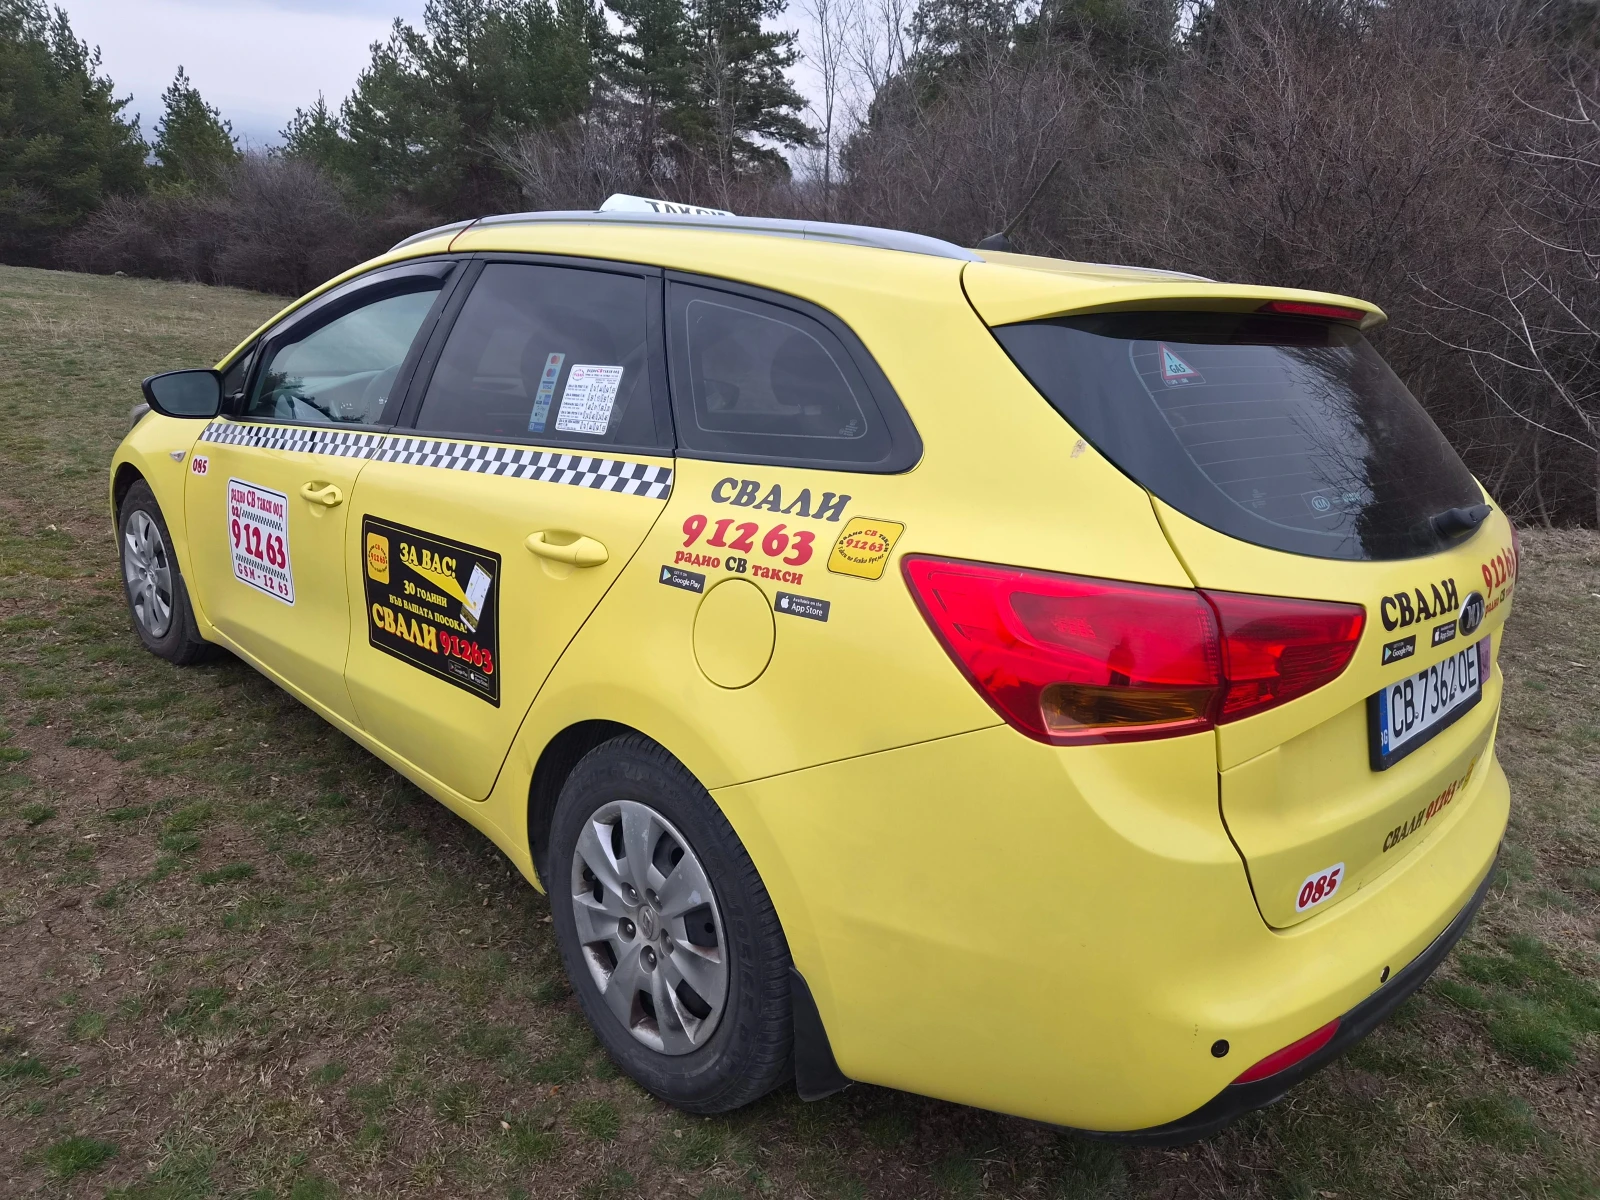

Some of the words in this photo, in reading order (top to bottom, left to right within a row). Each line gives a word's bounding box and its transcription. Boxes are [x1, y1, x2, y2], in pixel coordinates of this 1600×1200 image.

[1169, 363, 1186, 374] GAS
[192, 458, 208, 474] 085
[711, 477, 852, 522] СВАЛИ
[237, 563, 256, 581] GSM
[399, 542, 418, 566] ЗА
[421, 548, 457, 579] ВАС!
[674, 550, 721, 569] радио
[725, 556, 748, 573] СВ
[752, 564, 804, 586] такси
[403, 579, 416, 595] 30
[416, 587, 448, 608] ГОДИНИ
[672, 575, 690, 586] Google
[690, 579, 701, 590] Play
[388, 594, 403, 607] ВЪВ
[403, 601, 433, 619] ВАШАТА
[791, 602, 805, 613] App
[805, 605, 823, 616] Store
[1381, 578, 1459, 631] СВАЛИ
[372, 603, 438, 653] СВАЛИ
[439, 630, 494, 675] 91263
[1392, 646, 1406, 657] Google
[1382, 808, 1427, 853] СВАЛИ
[1298, 868, 1341, 908] 085
